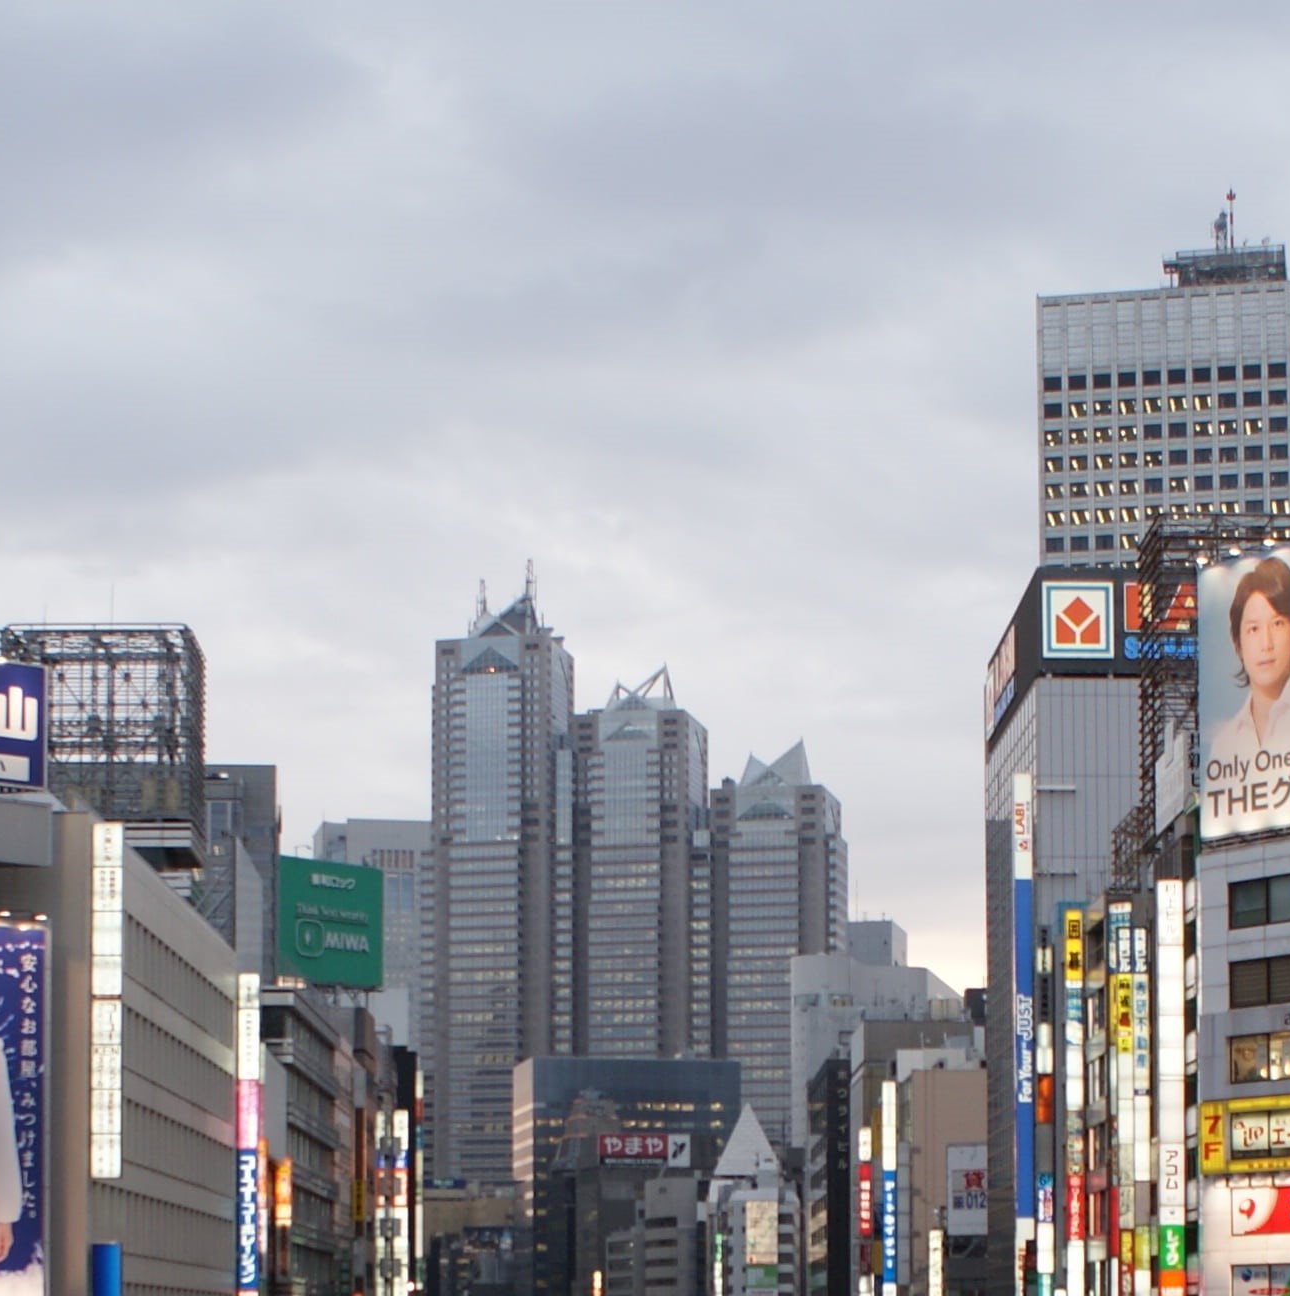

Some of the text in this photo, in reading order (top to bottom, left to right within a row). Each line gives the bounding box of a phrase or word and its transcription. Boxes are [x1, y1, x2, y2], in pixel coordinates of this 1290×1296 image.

[1206, 757, 1250, 784] Only
[1015, 802, 1026, 836] LABI
[325, 930, 369, 952] MIWA
[1017, 995, 1034, 1104] For Your JUST
[19, 953, 39, 1220] 安心なお部屋、みつけました。
[602, 1137, 665, 1155] やまや
[1203, 1115, 1222, 1162] 7F
[1165, 1150, 1179, 1191] アコム
